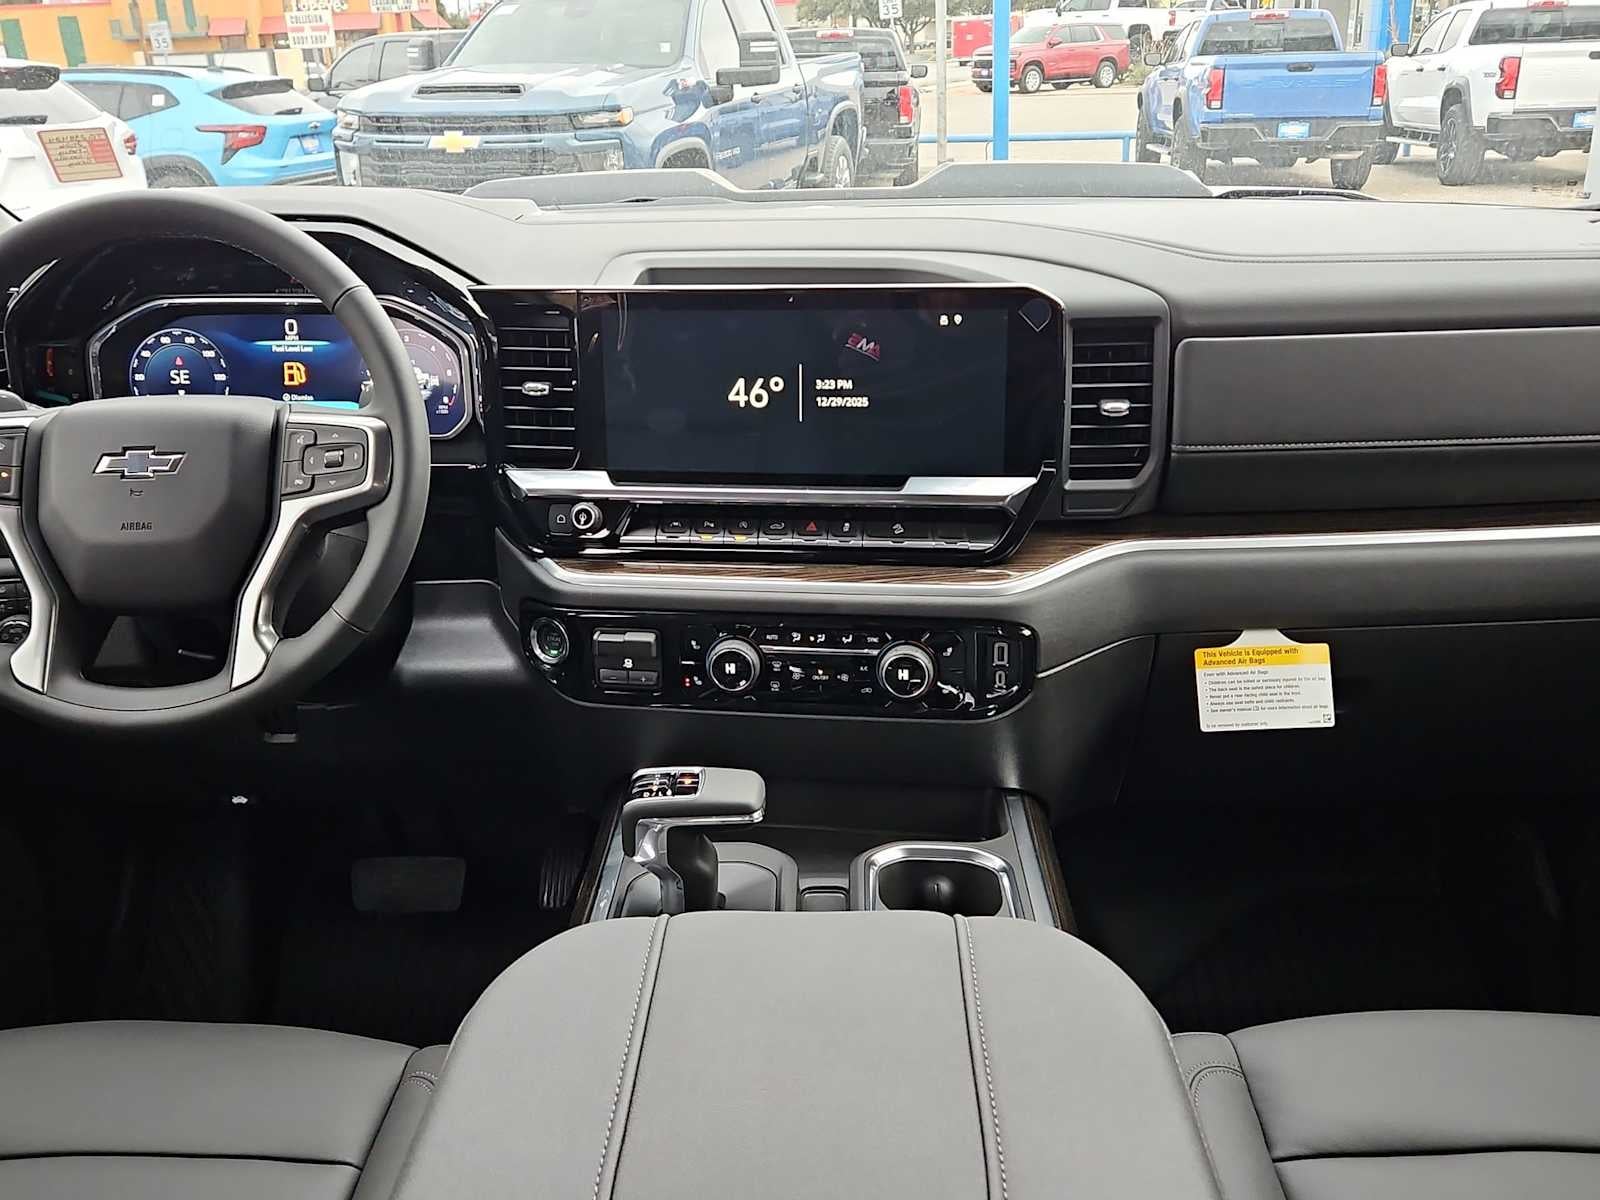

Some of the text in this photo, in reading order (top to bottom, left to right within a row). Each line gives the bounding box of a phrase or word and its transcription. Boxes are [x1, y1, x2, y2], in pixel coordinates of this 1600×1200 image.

[883, 4, 898, 15] 35
[153, 38, 168, 48] 35
[169, 369, 191, 385] SE
[815, 379, 853, 390] 3:23 PM
[727, 376, 785, 408] 46°
[816, 396, 869, 408] 12/29/2025
[120, 522, 153, 531] AIRBAG
[1218, 649, 1243, 657] Vehicle
[1252, 648, 1283, 657] Equipped
[1202, 656, 1266, 666] Advanced Air Bags
